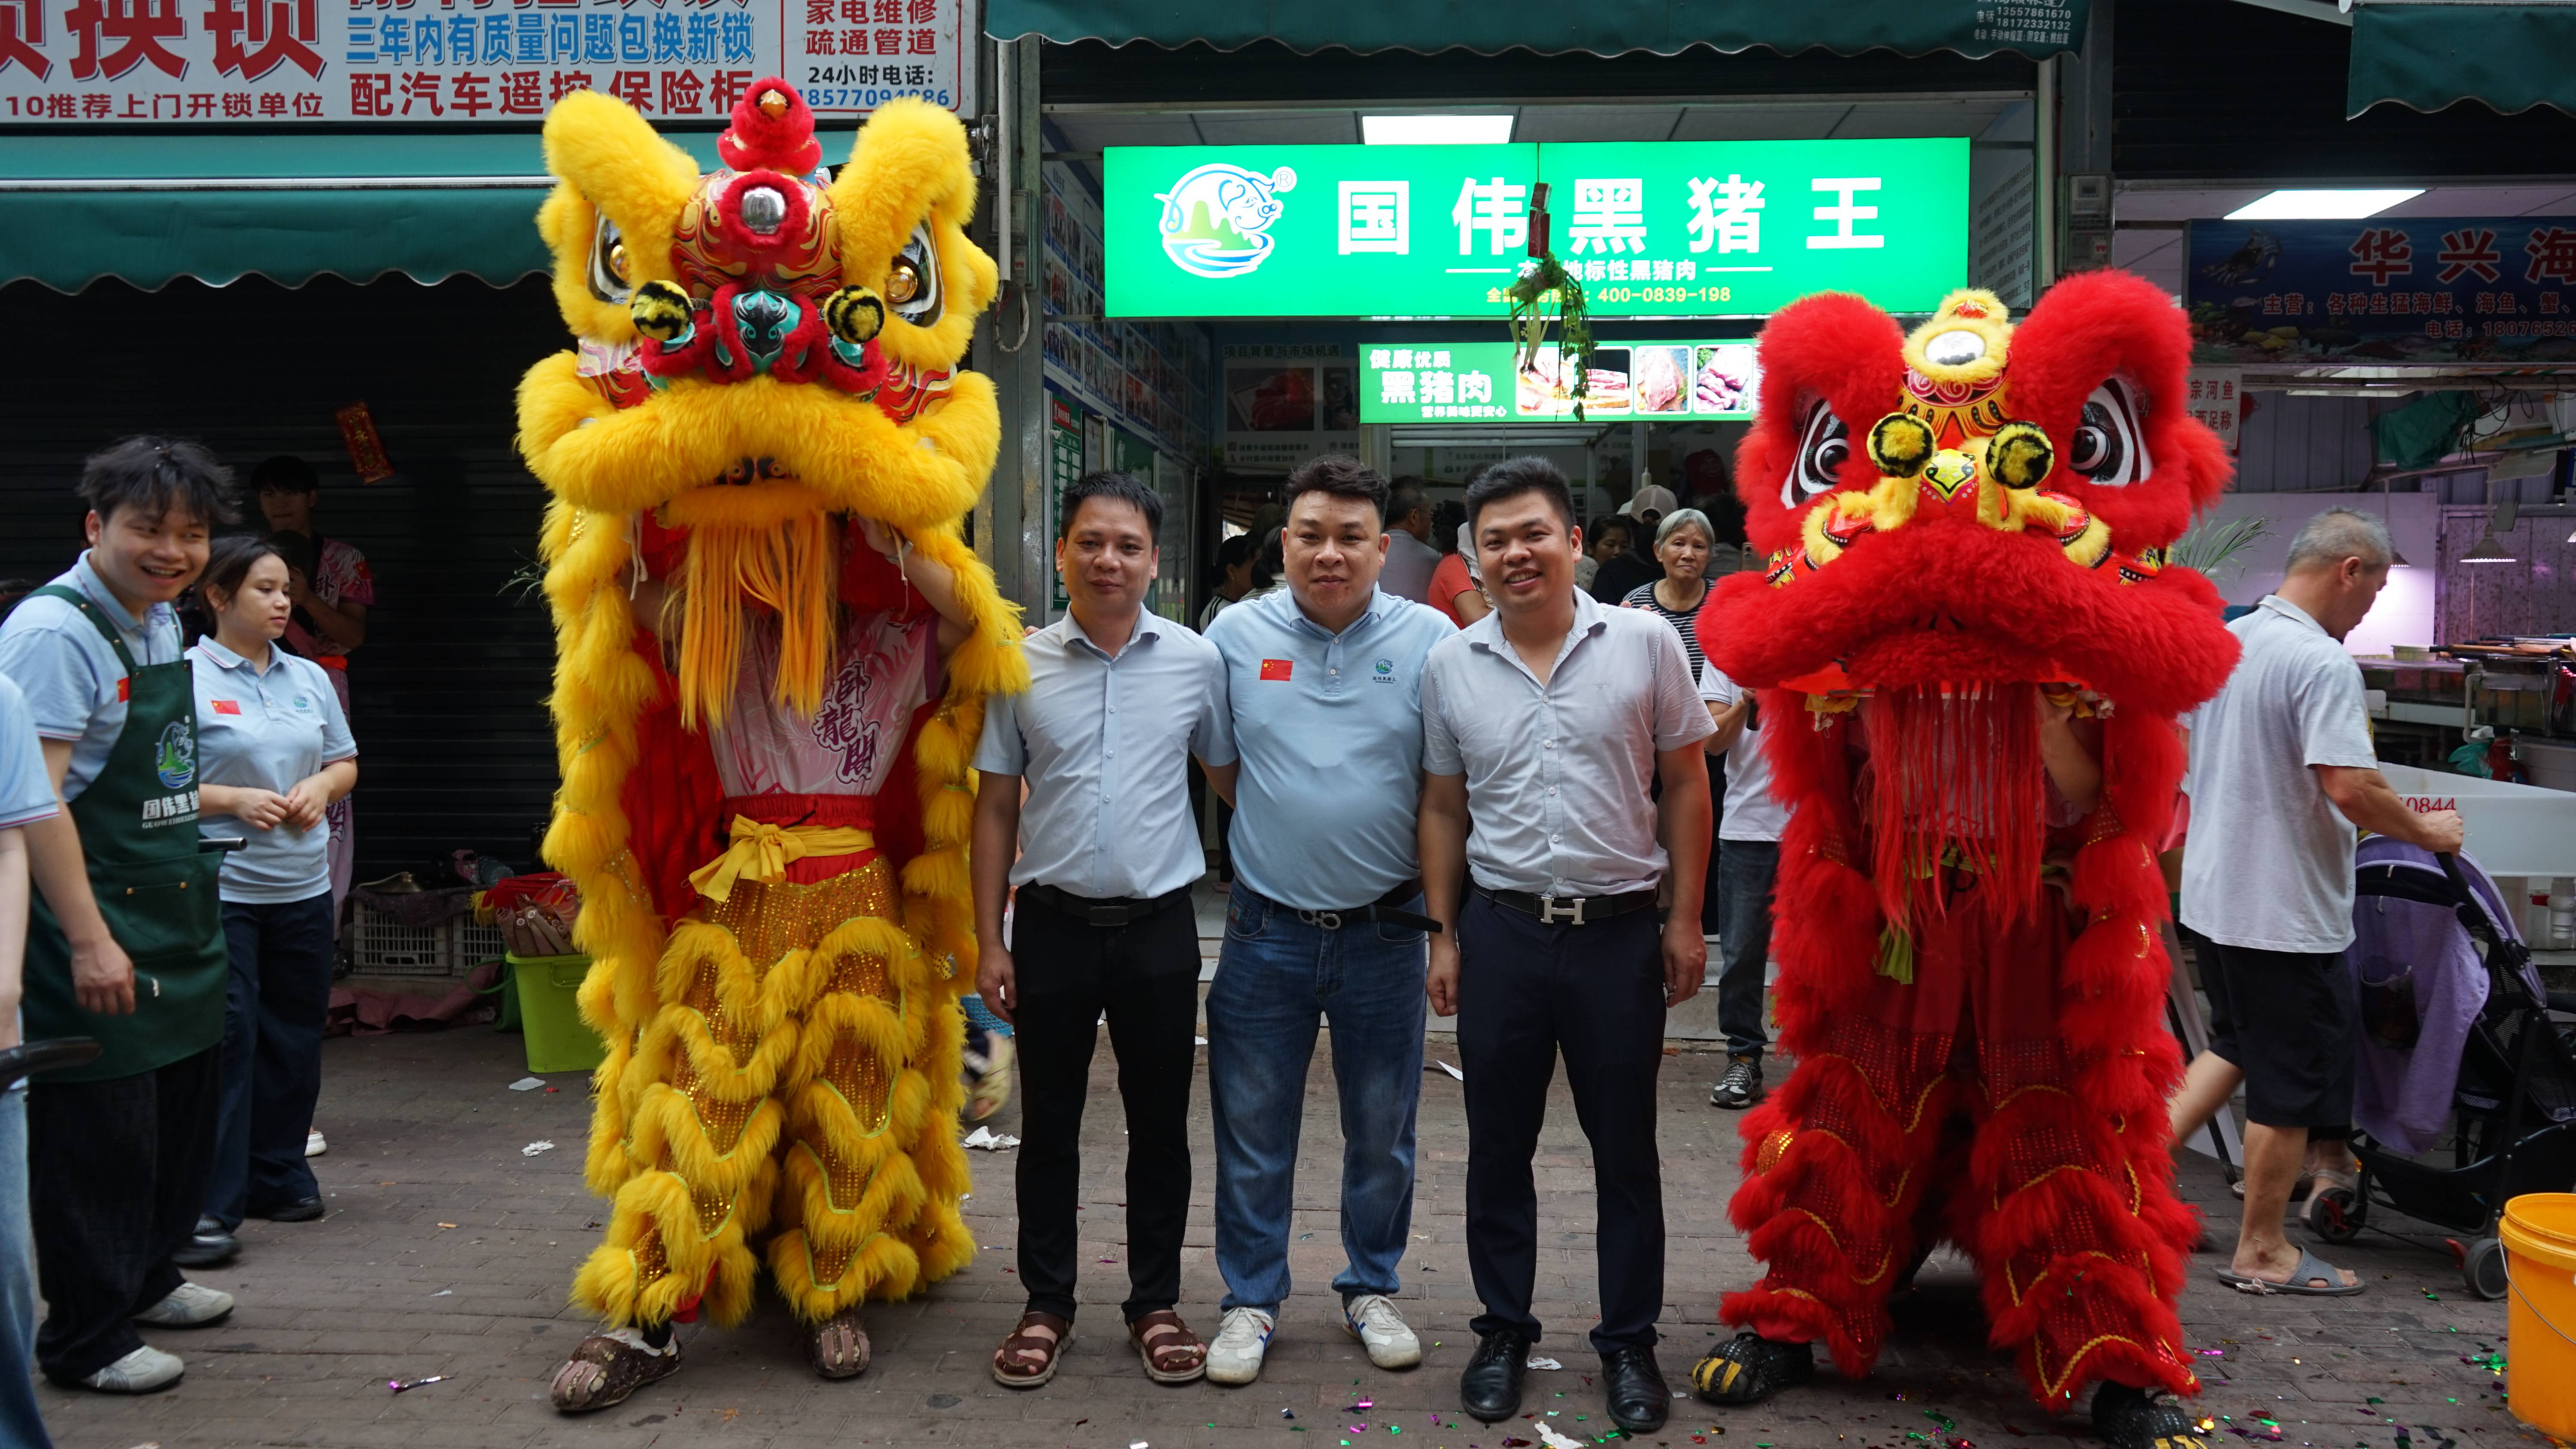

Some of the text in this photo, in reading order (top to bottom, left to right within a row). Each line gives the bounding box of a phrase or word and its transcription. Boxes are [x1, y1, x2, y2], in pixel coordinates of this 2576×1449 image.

[806, 0, 937, 24] 家电维修
[1977, 9, 1995, 22] 电话
[1997, 6, 2071, 19] 13557861670
[1997, 18, 2071, 30] 18172332132
[346, 12, 754, 65] 三年内有质量问题包换新锁
[806, 28, 936, 55] 疏通管道
[6, 93, 325, 119] 10推荐上门开锁单位
[1337, 175, 1886, 256] 国伟黑猪王
[1517, 259, 1696, 282] 本地标性黑猪肉
[1370, 349, 1451, 369] 健康优质
[1381, 370, 1492, 404] 黑猪肉
[1421, 405, 1507, 418] 营养美味更安心
[2400, 797, 2456, 813] 0844
